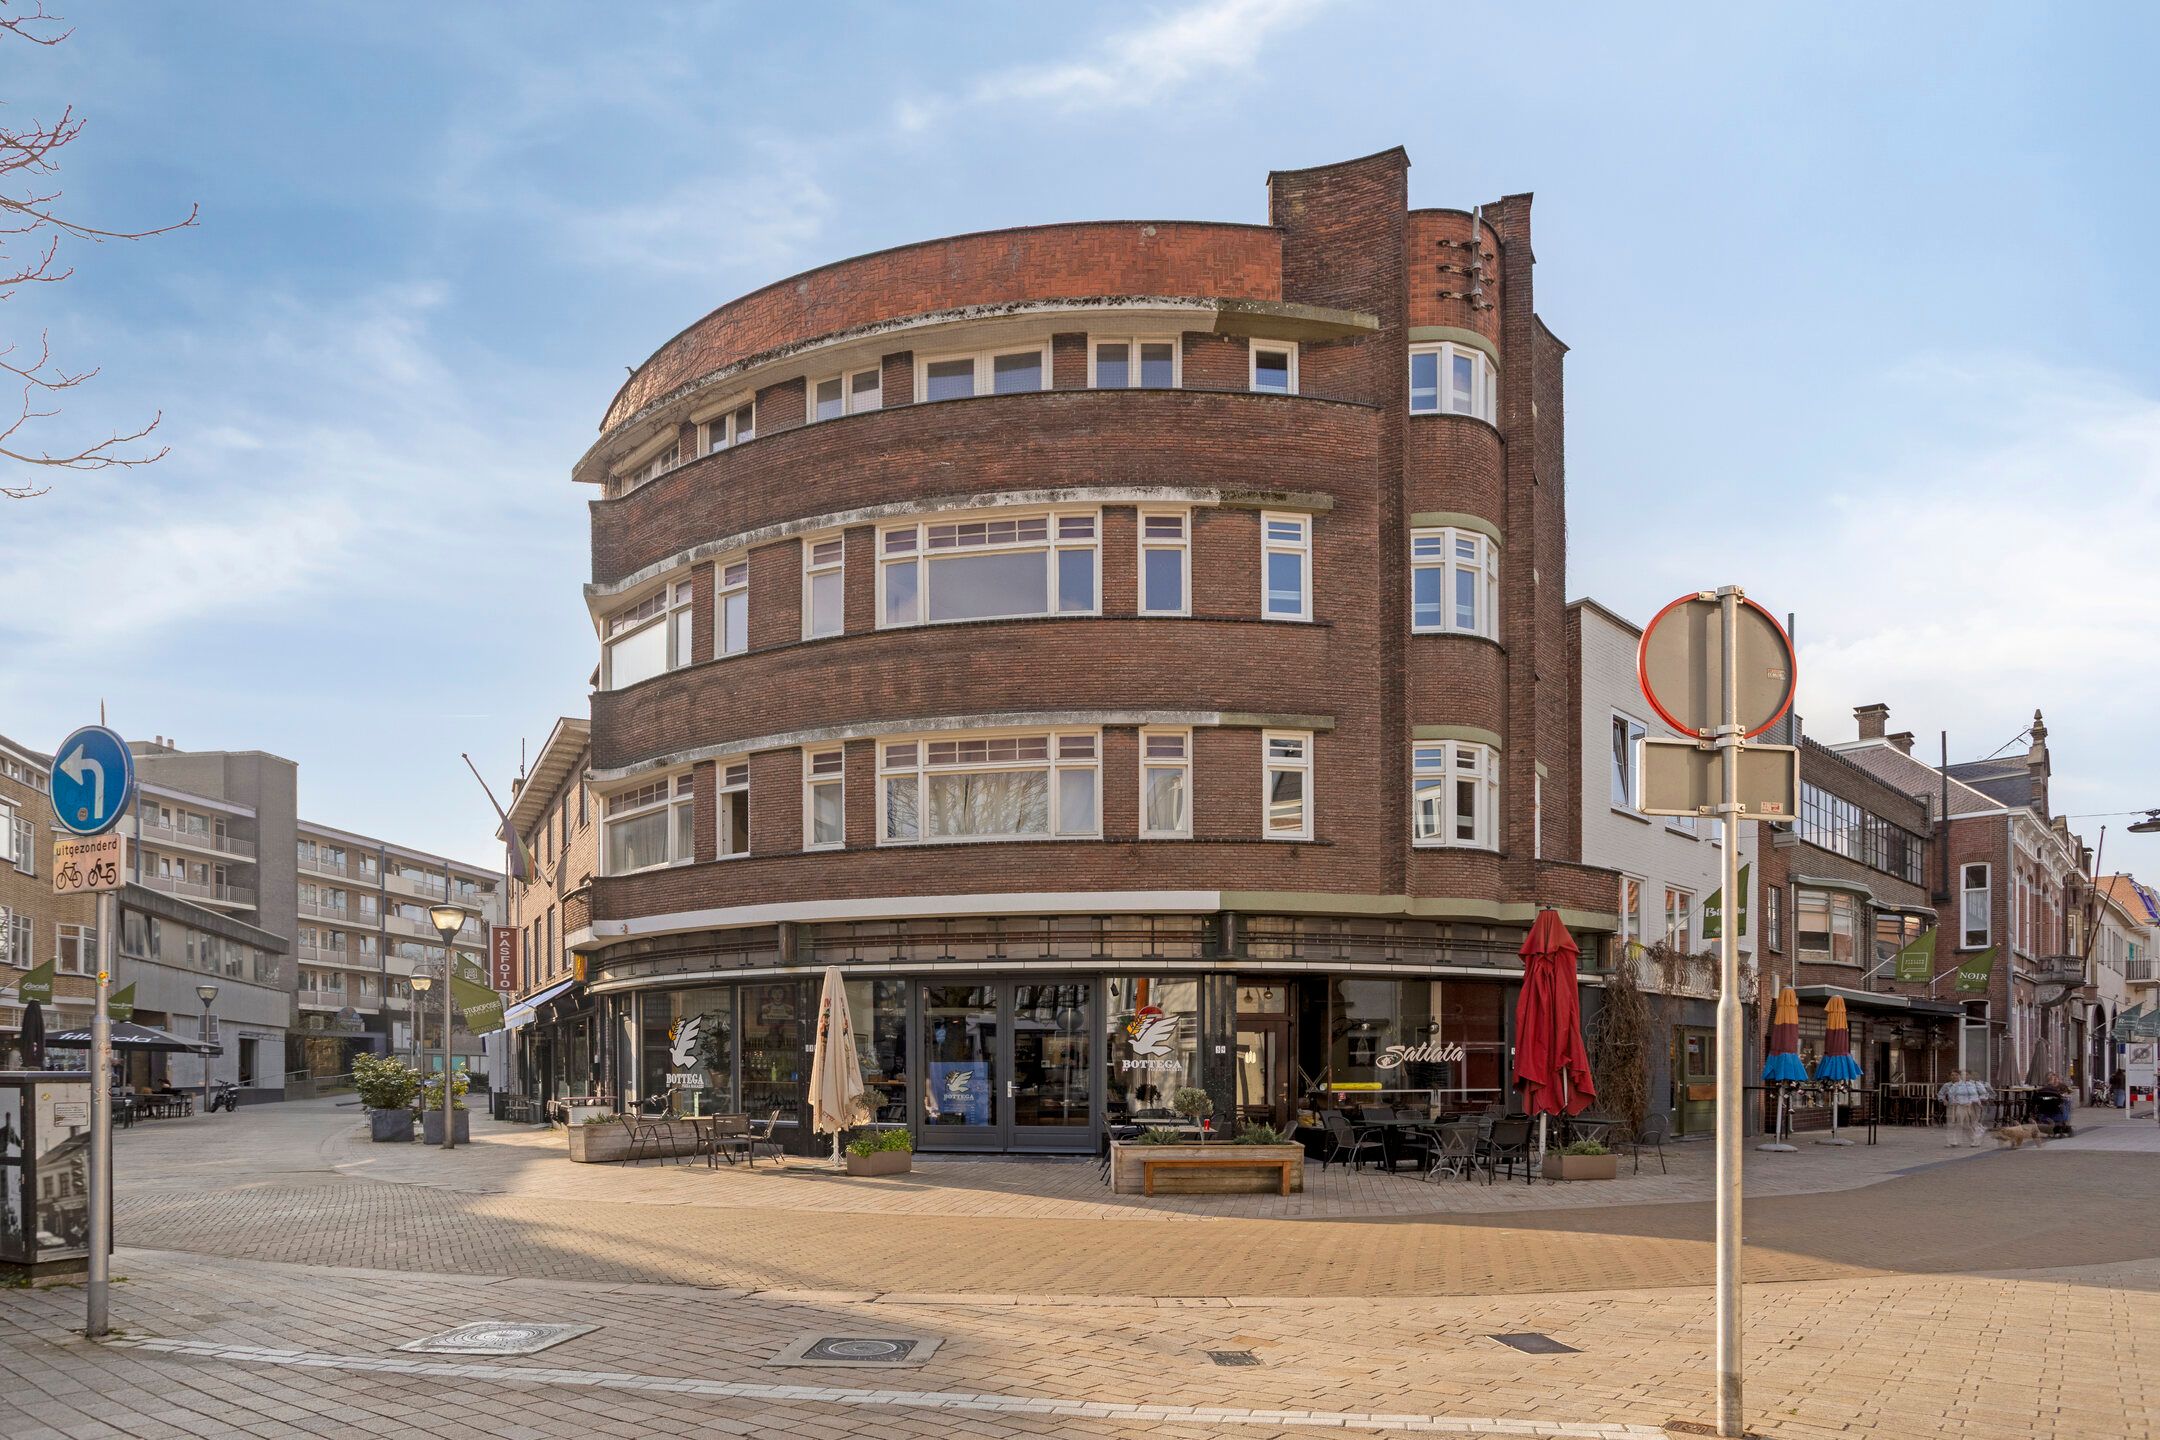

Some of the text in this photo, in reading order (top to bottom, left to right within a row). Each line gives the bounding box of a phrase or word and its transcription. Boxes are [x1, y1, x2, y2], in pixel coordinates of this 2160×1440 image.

[56, 838, 118, 857] uitgezonderd
[499, 931, 511, 988] PASFOTO
[1376, 1040, 1465, 1069] Satiata
[1122, 1060, 1182, 1069] BOTTEGA
[666, 1073, 704, 1084] BOTTEGA
